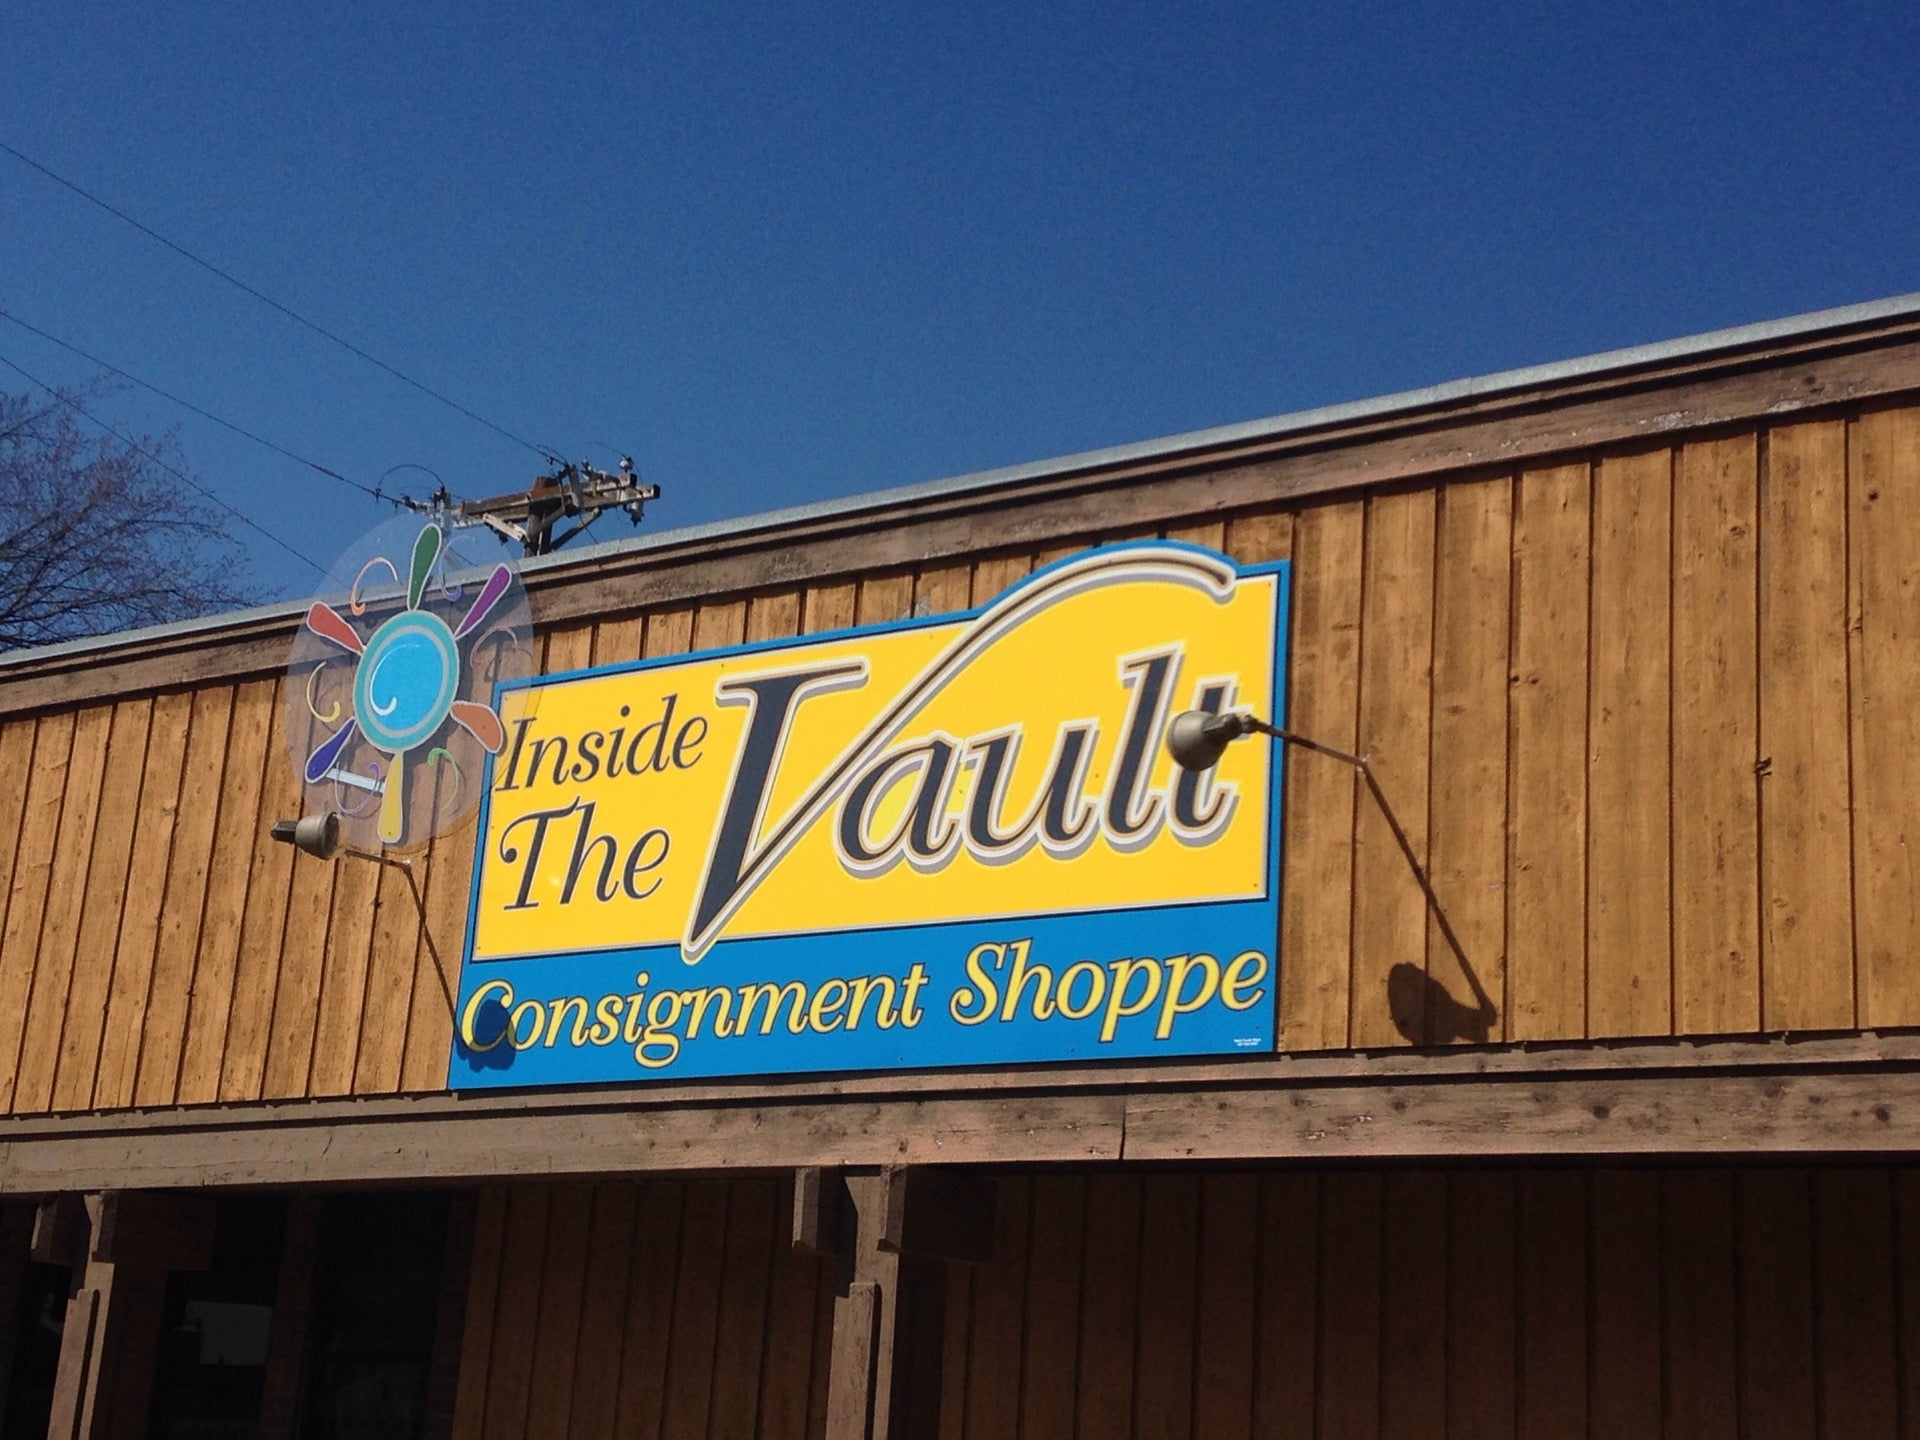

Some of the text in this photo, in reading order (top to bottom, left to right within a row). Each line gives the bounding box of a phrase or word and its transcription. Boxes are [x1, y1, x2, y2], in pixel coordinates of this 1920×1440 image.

[494, 692, 708, 793] Inside
[499, 548, 1253, 963] The Vault
[460, 937, 1269, 1068] Consignment Shoppe
